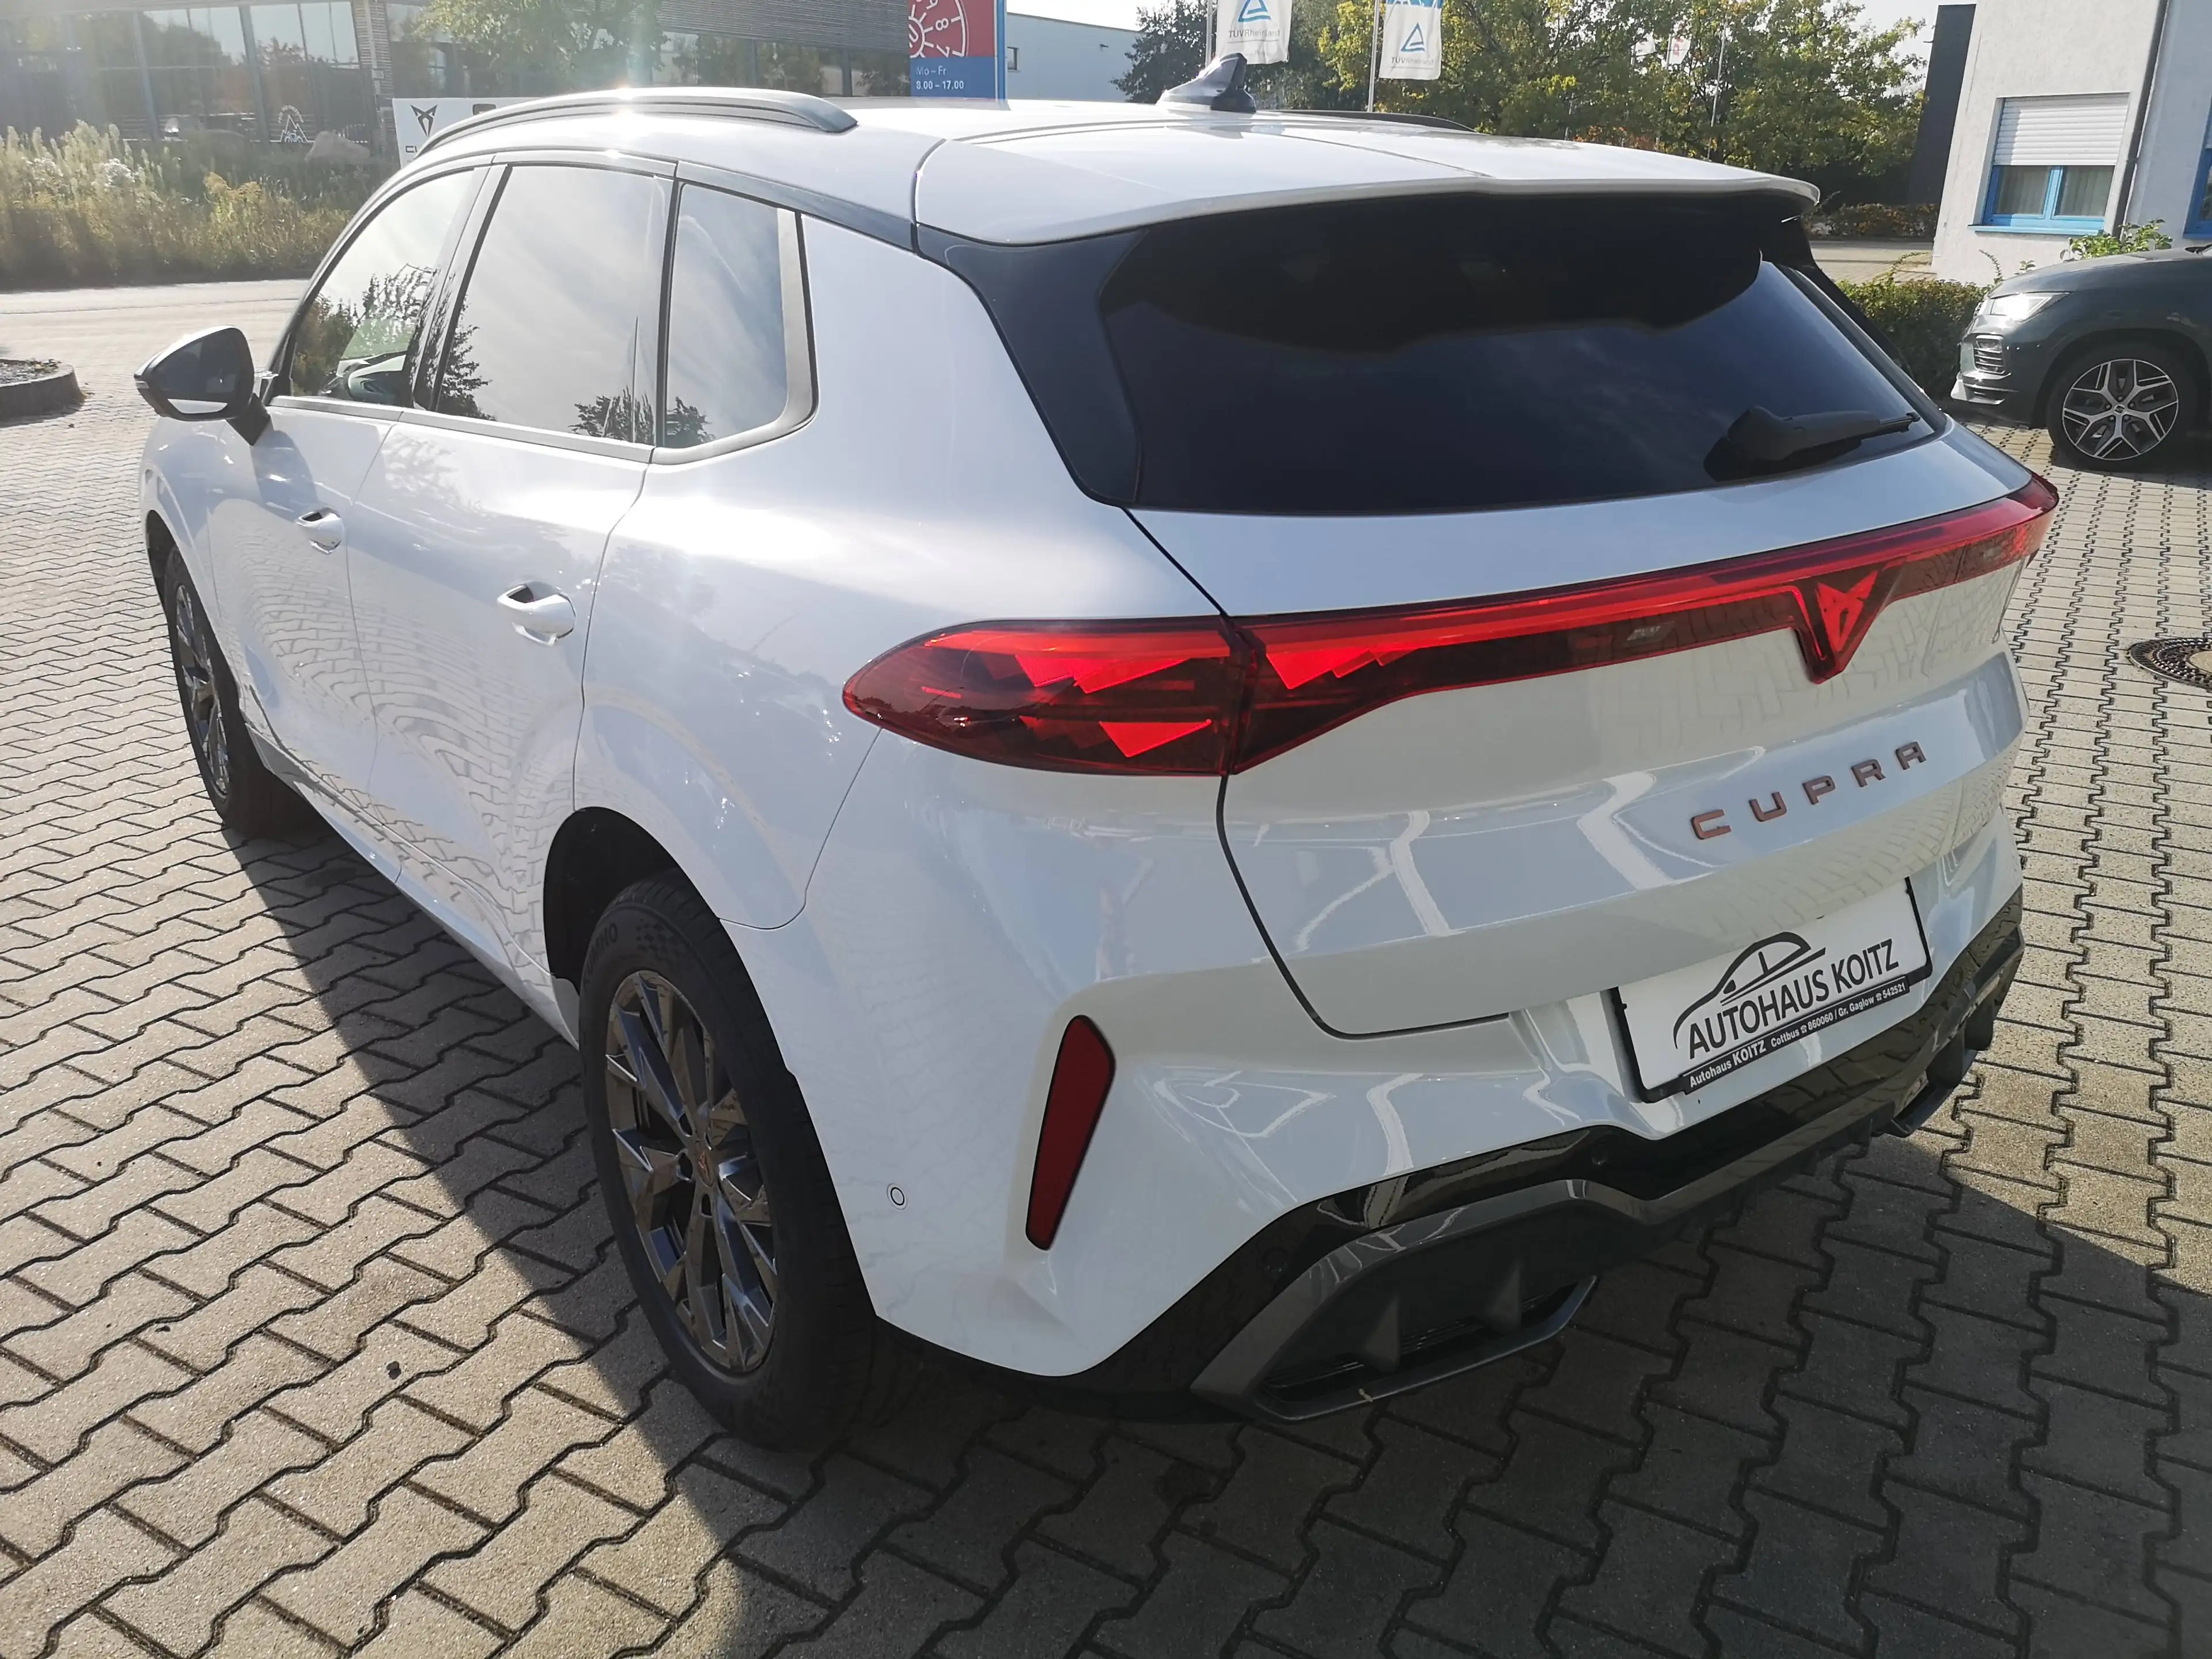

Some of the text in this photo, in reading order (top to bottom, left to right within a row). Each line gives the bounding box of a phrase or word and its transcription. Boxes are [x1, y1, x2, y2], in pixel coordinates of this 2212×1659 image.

[935, 18, 949, 31] 8
[916, 66, 929, 75] Mo
[938, 65, 946, 75] Fr
[916, 81, 933, 89] 8.00
[942, 80, 964, 89] 17.00
[1690, 740, 1927, 840] CUPRA
[1690, 938, 1899, 1059] AUTOHAUS KOITZ
[1690, 1060, 1732, 1088] Autohaus
[1732, 1039, 1767, 1067] KOITZ
[1771, 1028, 1800, 1048] Cottbus
[1808, 1011, 1834, 1031] 860060
[1838, 1007, 1849, 1017] Gr.
[1849, 995, 1874, 1013] Gaglow
[1883, 982, 1906, 999] 542521
